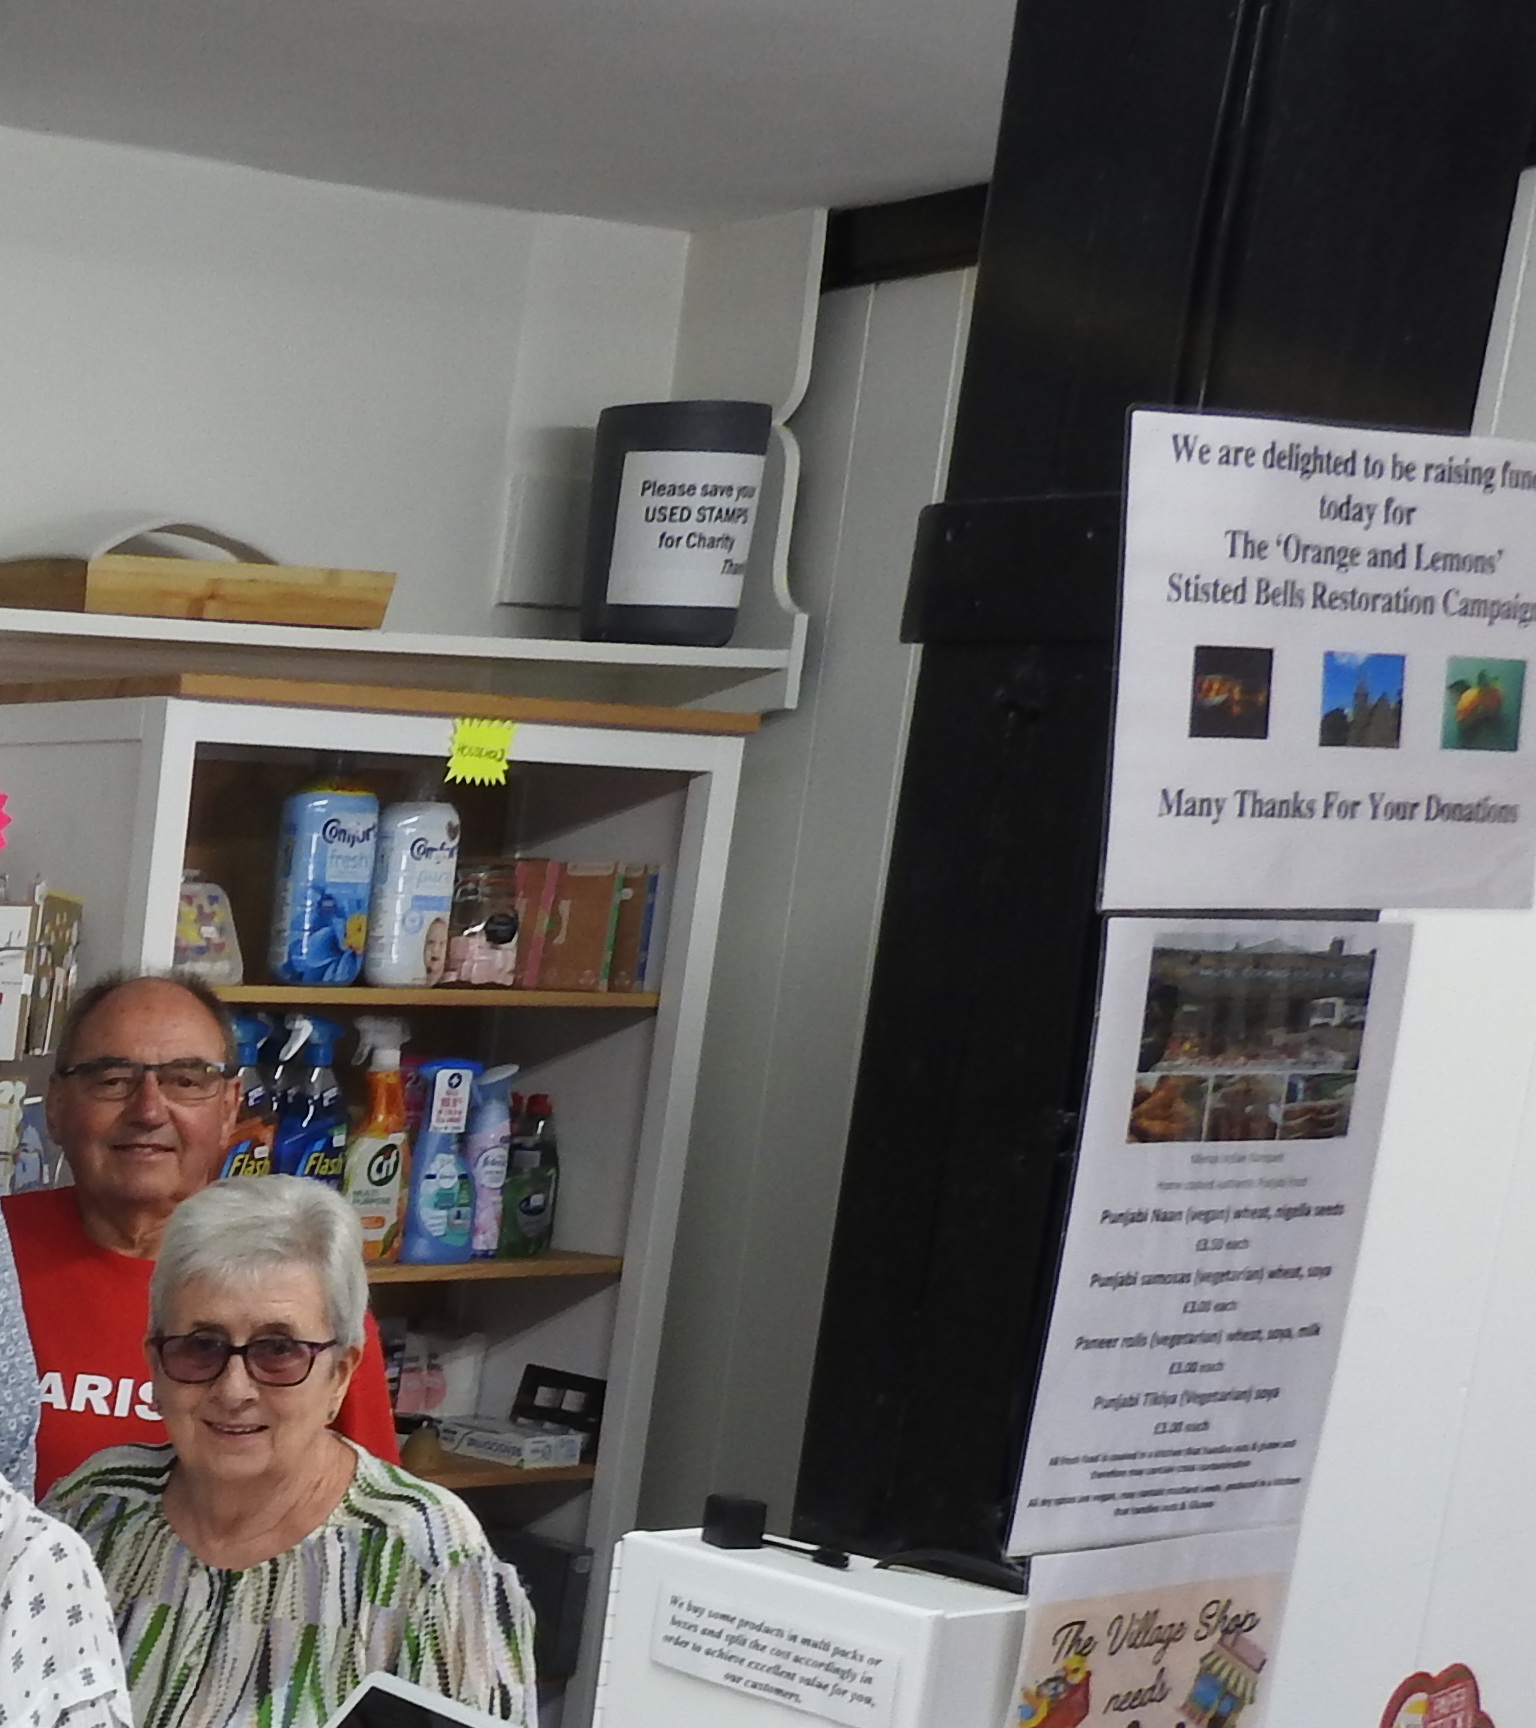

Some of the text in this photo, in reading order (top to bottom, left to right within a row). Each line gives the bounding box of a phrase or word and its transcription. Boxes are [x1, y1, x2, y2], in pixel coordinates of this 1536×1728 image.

[1172, 433, 1496, 495] We are delighted to be raising
[640, 479, 734, 498] Please save
[644, 505, 749, 525] USED STAMPS
[1319, 494, 1417, 530] today for
[658, 530, 736, 554] for Charity
[1224, 529, 1269, 561] The
[1367, 542, 1407, 569] and
[1166, 572, 1247, 605] Stisted
[1255, 577, 1305, 609] Bells
[1311, 581, 1435, 616] Restoration
[1158, 787, 1520, 824] Many Thanks For Your Donations
[1100, 1208, 1148, 1227] Punjabi
[1090, 1271, 1138, 1289] Punjabi
[38, 1371, 164, 1421] ARIS
[1092, 1393, 1140, 1411] Punjabi
[669, 1614, 698, 1634] boxes
[700, 1624, 722, 1640] and
[748, 1637, 767, 1653] the
[792, 1653, 858, 1683] accordingly
[859, 1670, 873, 1686] in
[686, 1599, 705, 1618] buy
[707, 1608, 737, 1624] some
[736, 1617, 784, 1640] products
[786, 1628, 798, 1643] in
[800, 1635, 831, 1652] multi
[830, 1644, 864, 1663] packs
[866, 1656, 883, 1667] or
[1052, 1599, 1260, 1666] The Village Shop
[662, 1632, 690, 1649] order
[691, 1640, 702, 1653] to
[704, 1645, 746, 1667] achieve
[747, 1659, 797, 1682] excellent
[798, 1672, 829, 1691] value
[828, 1681, 848, 1698] for
[723, 1671, 744, 1685] our
[1103, 1667, 1172, 1714] needs
